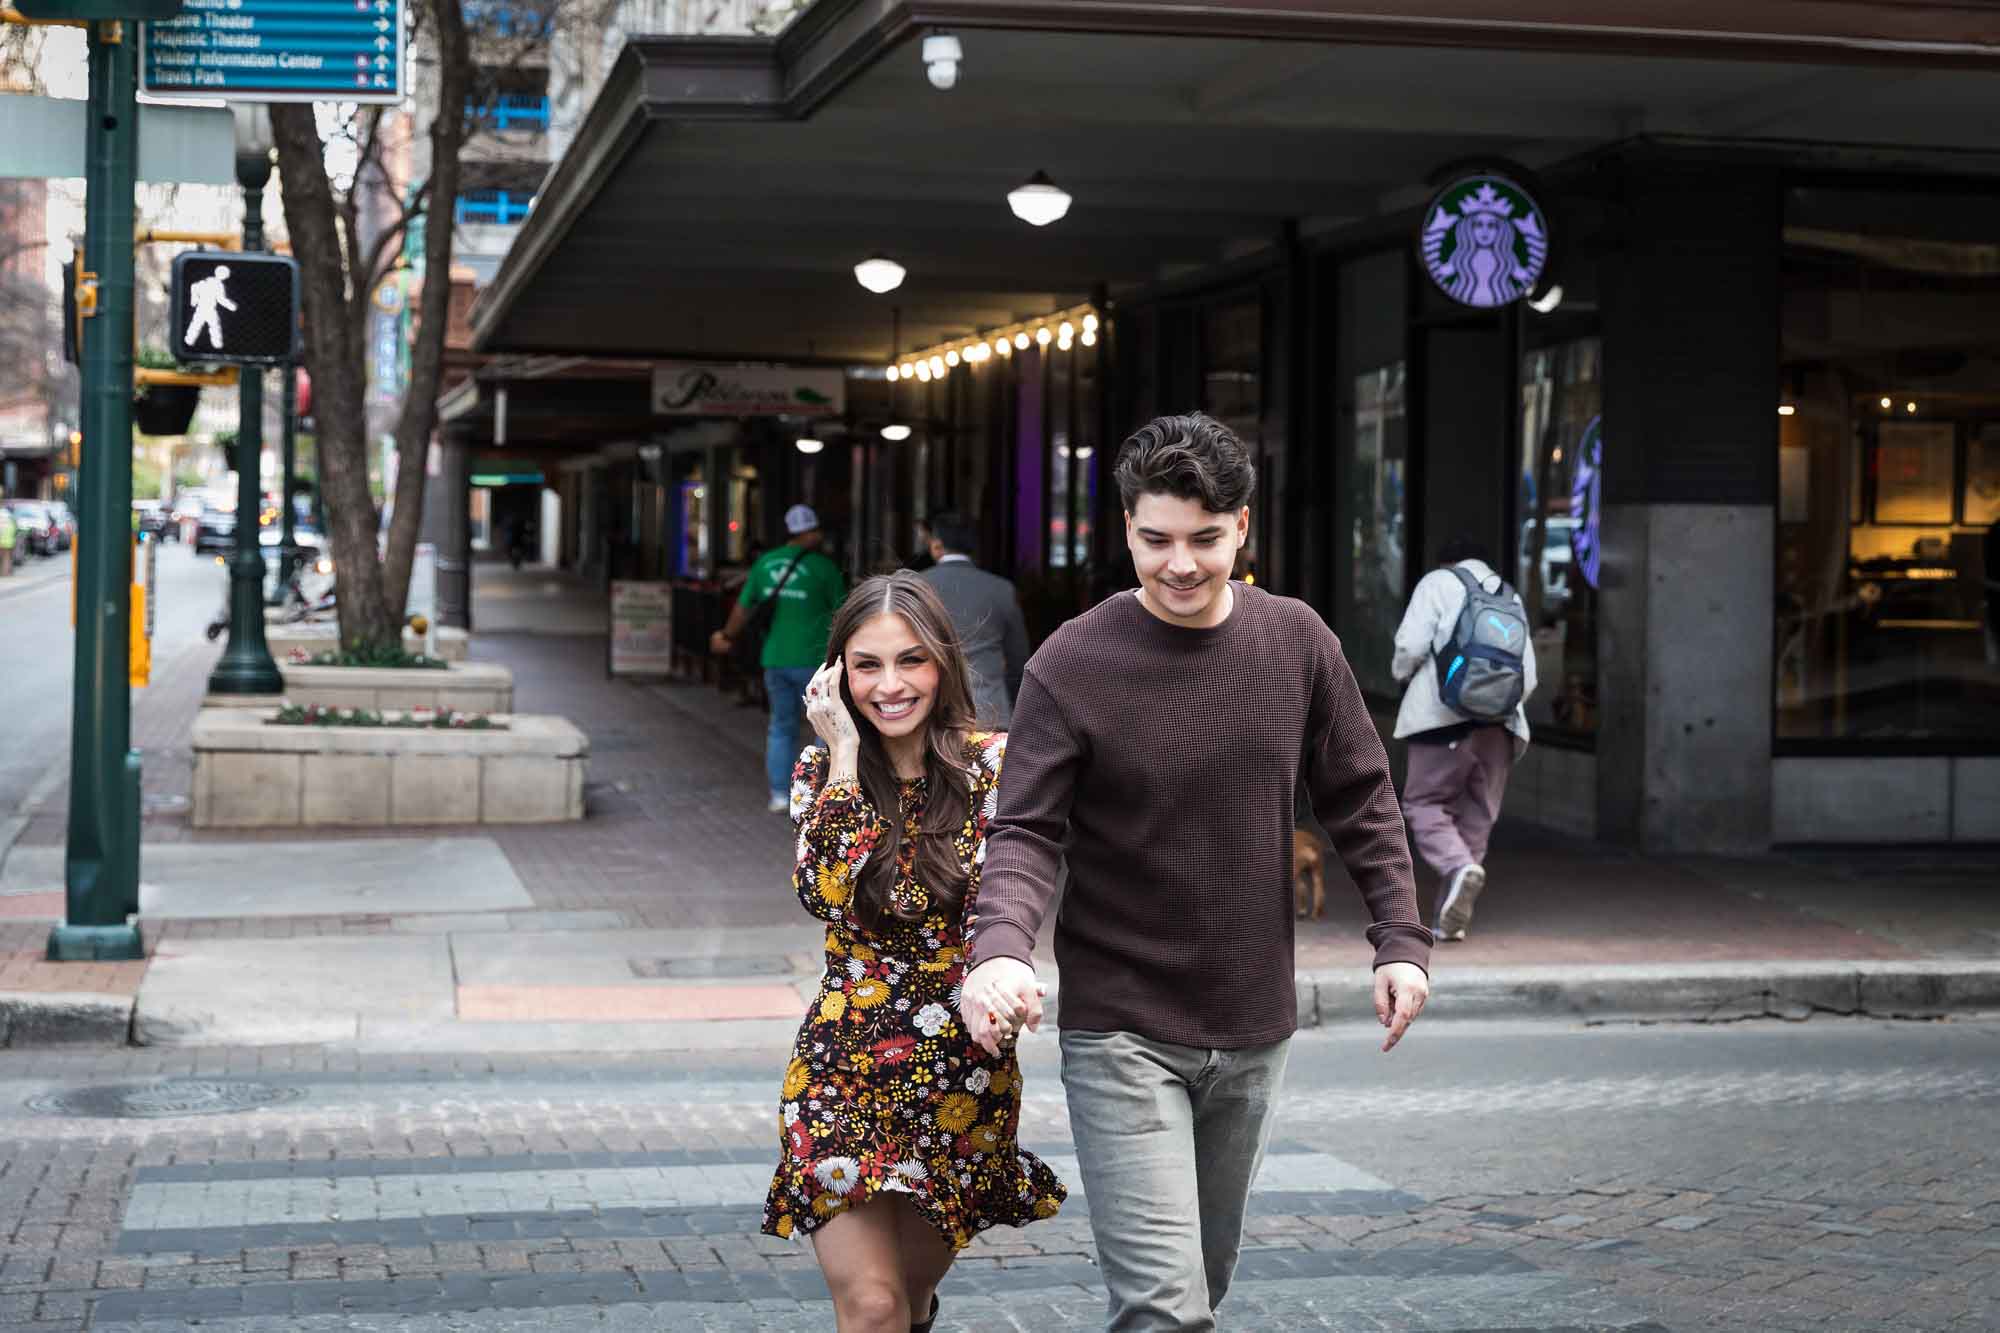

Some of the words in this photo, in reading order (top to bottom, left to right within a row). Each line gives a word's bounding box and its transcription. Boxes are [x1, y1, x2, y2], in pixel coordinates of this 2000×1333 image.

[204, 12, 255, 29] Theater
[153, 31, 206, 47] Majestic
[211, 31, 261, 48] Theater
[154, 50, 196, 65] Visitor
[200, 50, 275, 67] Information
[279, 52, 323, 69] Center
[155, 68, 192, 84] Travis
[195, 69, 225, 85] Park
